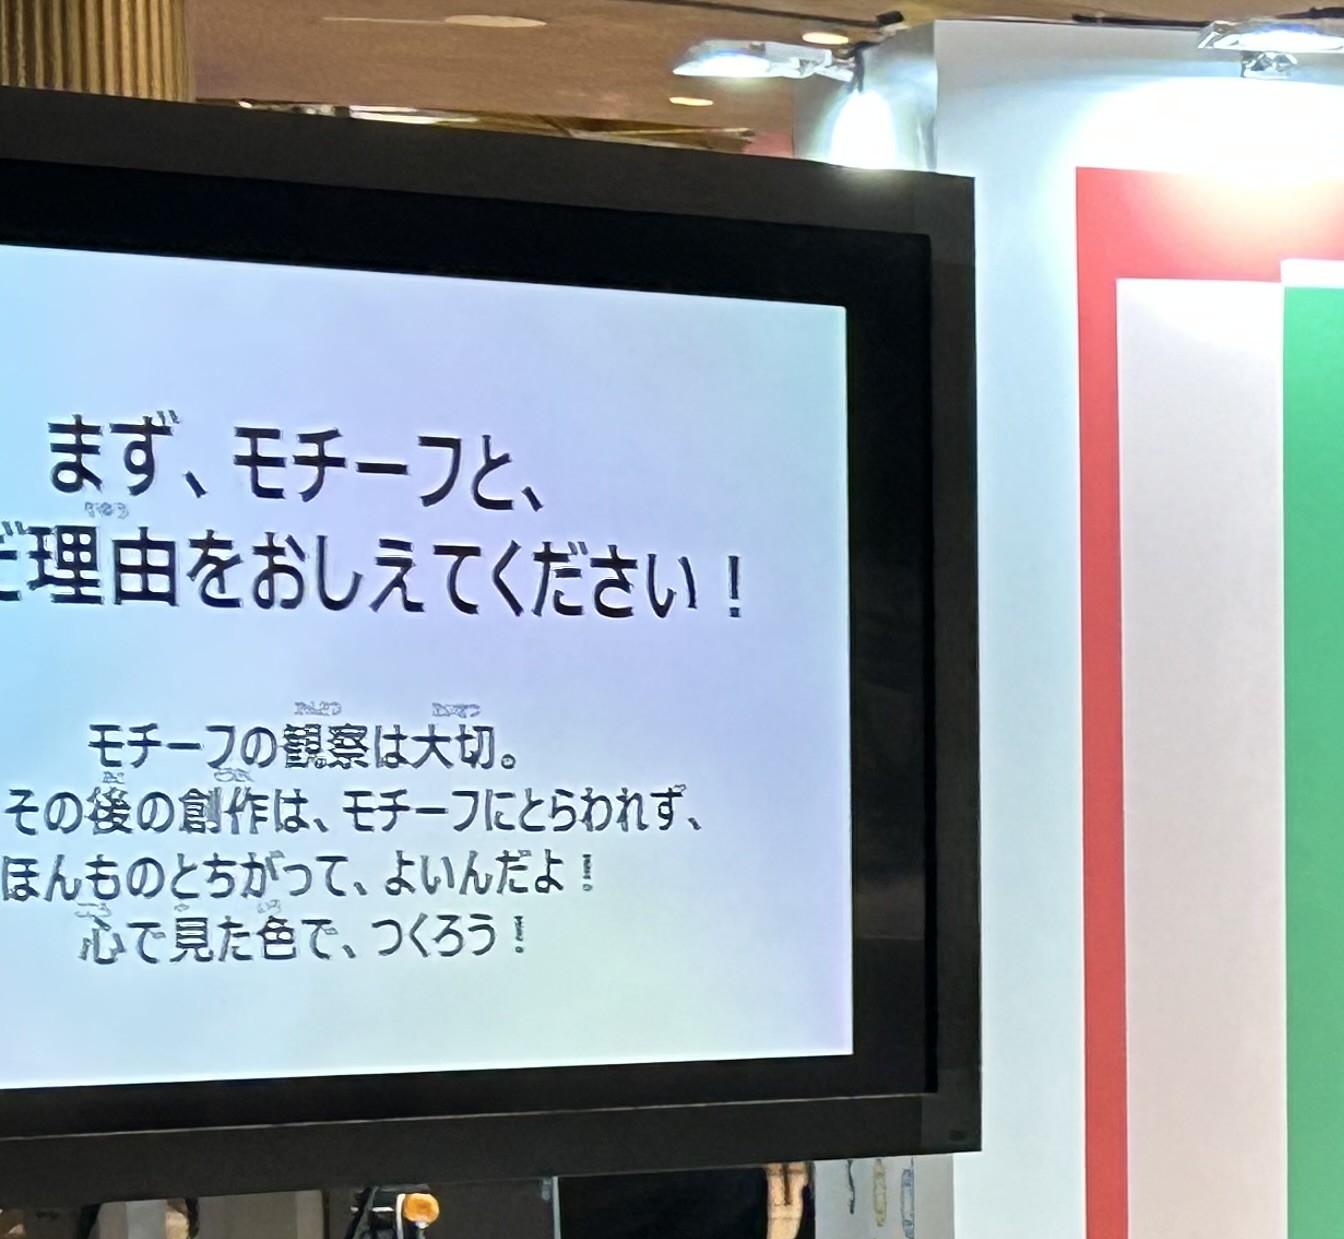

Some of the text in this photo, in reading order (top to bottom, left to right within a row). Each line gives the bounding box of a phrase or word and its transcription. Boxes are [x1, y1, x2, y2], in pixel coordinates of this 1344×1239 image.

[48, 410, 544, 511] まず、モチーフと、
[0, 521, 740, 618] 理由をおしえてください!
[88, 723, 516, 769] モチーフの観察は大切。
[5, 784, 702, 835] その後の創作は、モチーフにとらわれず、
[2, 849, 593, 901] ほんものとちがって、よいんだよ!
[78, 914, 525, 965] 心で見た色で、つくろう!
